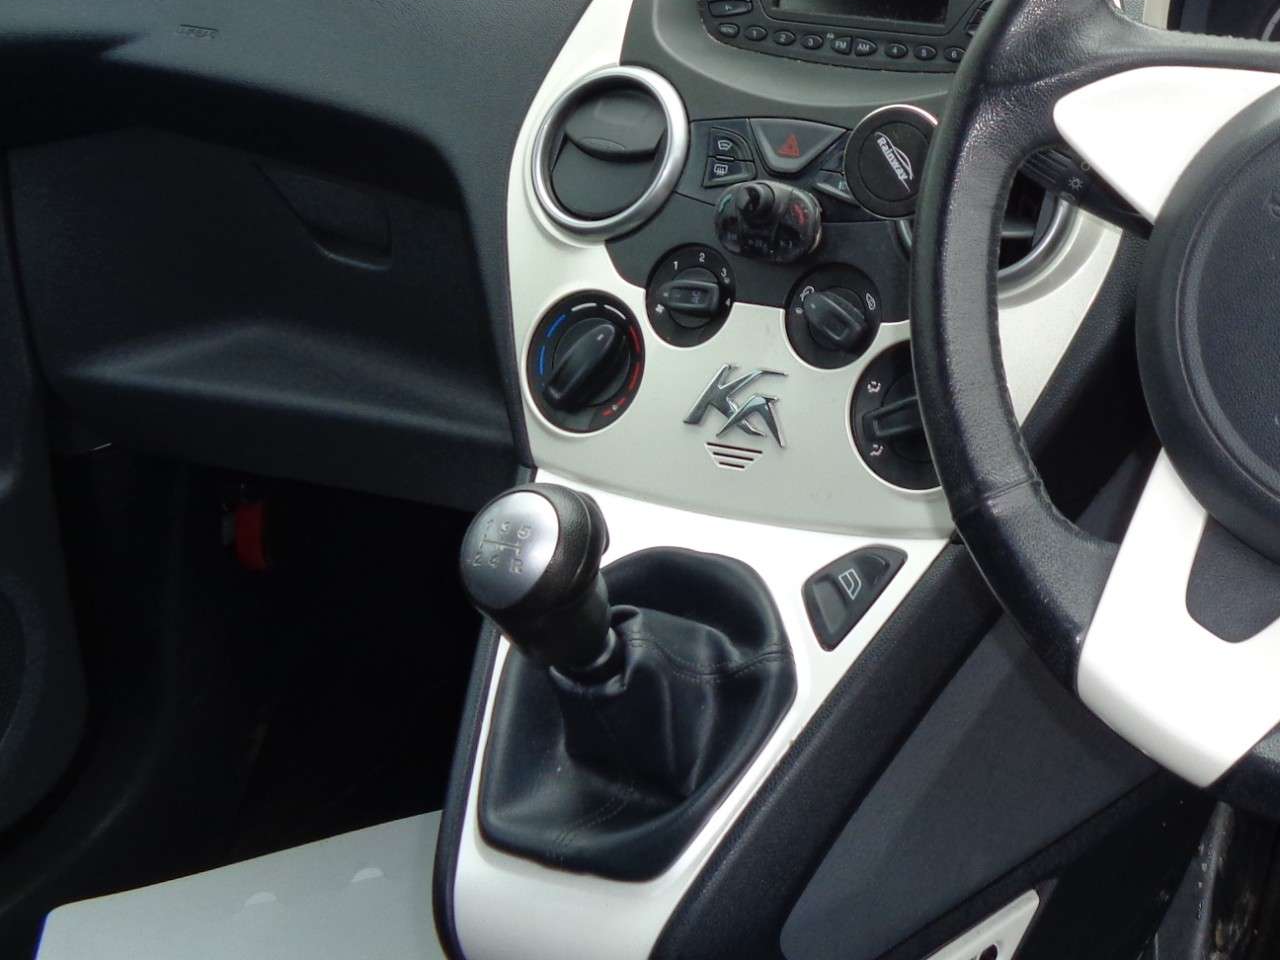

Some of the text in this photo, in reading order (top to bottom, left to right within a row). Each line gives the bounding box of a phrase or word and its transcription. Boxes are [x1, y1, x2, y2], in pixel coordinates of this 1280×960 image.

[808, 38, 814, 46] 3
[835, 40, 847, 49] FM
[857, 43, 869, 51] AM
[951, 50, 957, 58] 6
[876, 136, 910, 187] Rainway
[699, 252, 706, 263] 2
[672, 260, 679, 270] 1
[720, 267, 728, 278] 3
[683, 363, 788, 448] KA
[510, 558, 524, 575] R
